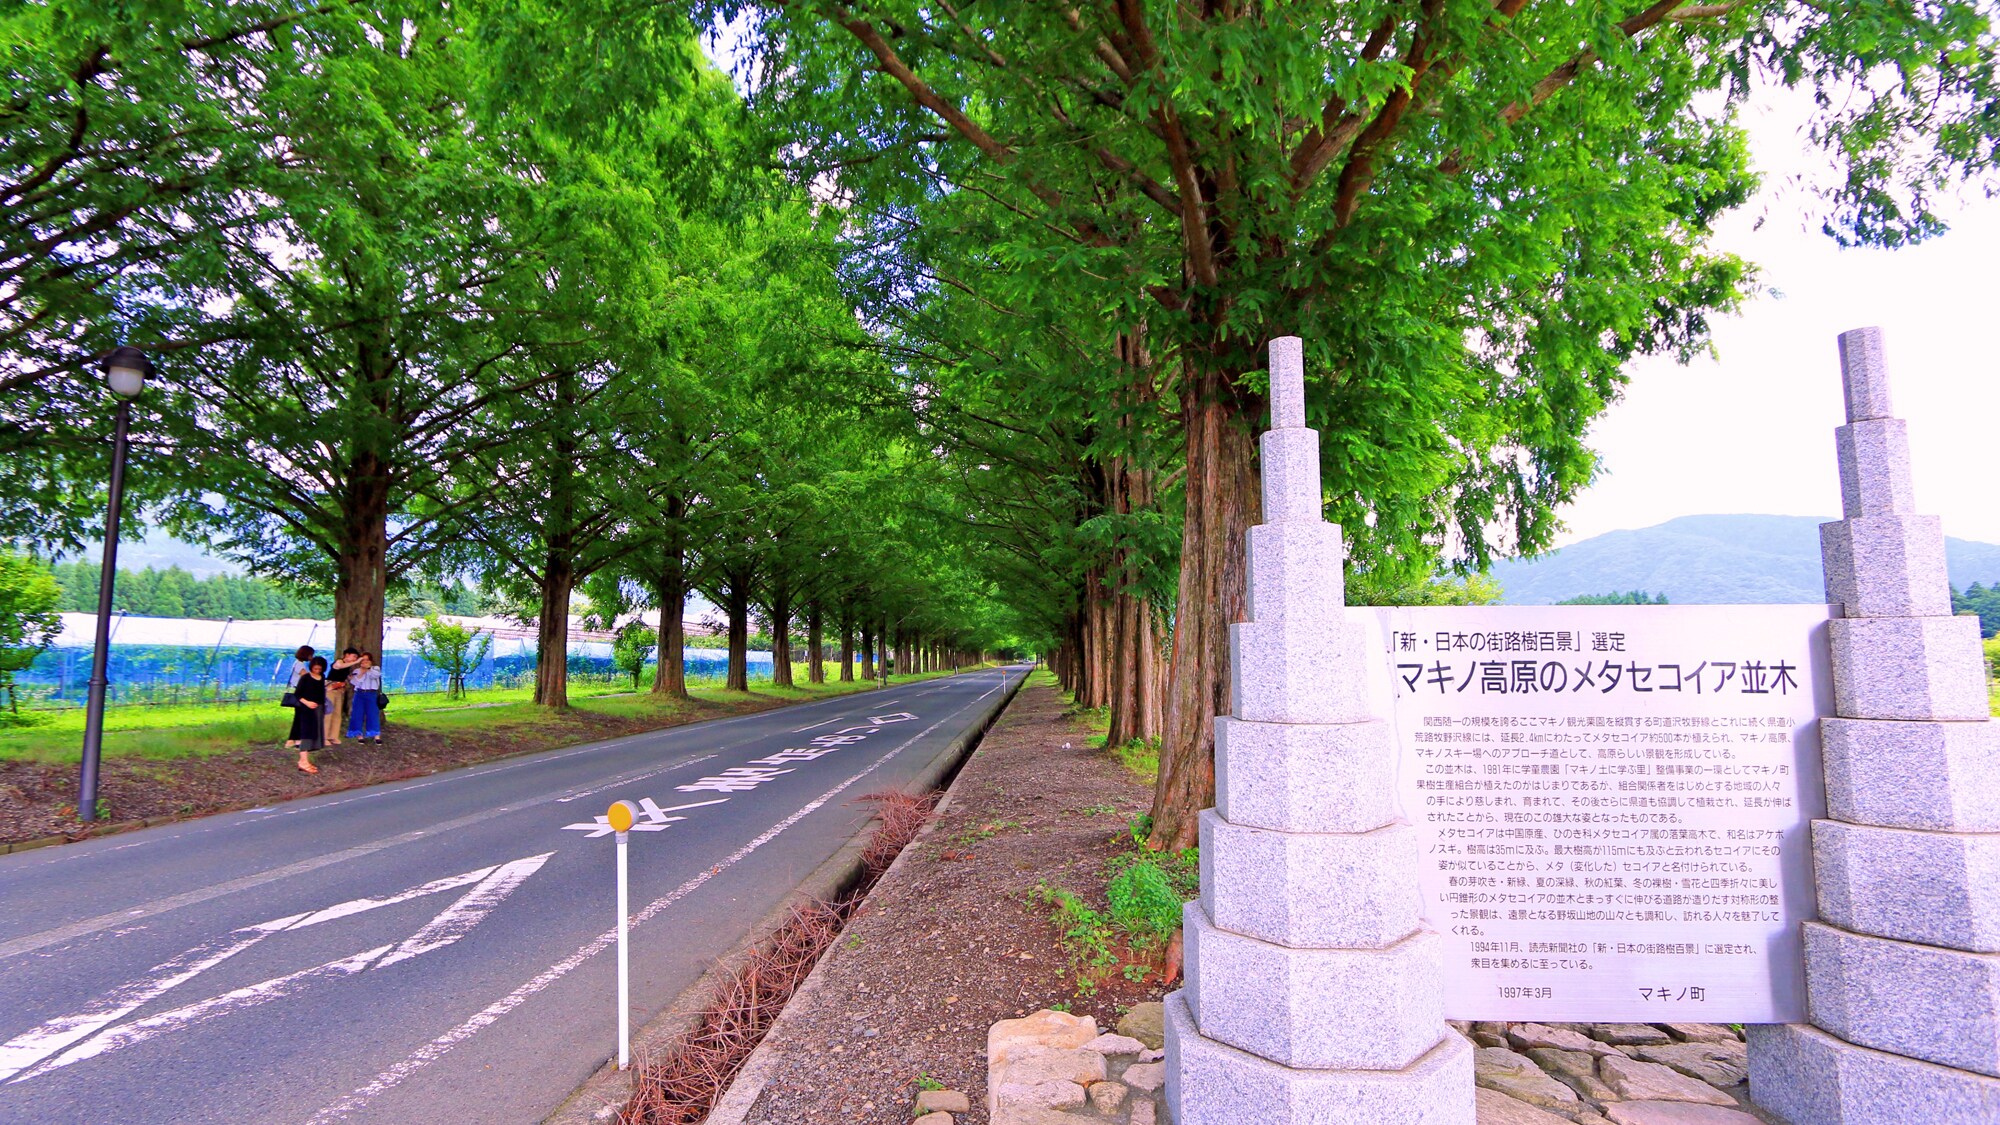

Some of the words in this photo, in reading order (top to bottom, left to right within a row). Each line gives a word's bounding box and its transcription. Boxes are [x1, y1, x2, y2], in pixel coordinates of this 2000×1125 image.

[1389, 630, 1627, 655] 「新・日本の街路樹百景」選定
[1396, 659, 1798, 695] マキノ高原のメタセコイア並木
[1426, 811, 1683, 824] されたことから、現在のこの雄大な姿となったものである。
[1451, 924, 1485, 937] くれる。
[1470, 941, 1757, 955] 1994年11月、読売新聞社の「新・日本の街路樹百景」に選定され、
[1470, 957, 1594, 970] 衆目を集めるに至っている。
[1496, 985, 1552, 999] 1997年3月
[1638, 986, 1706, 1003] マキノ町
